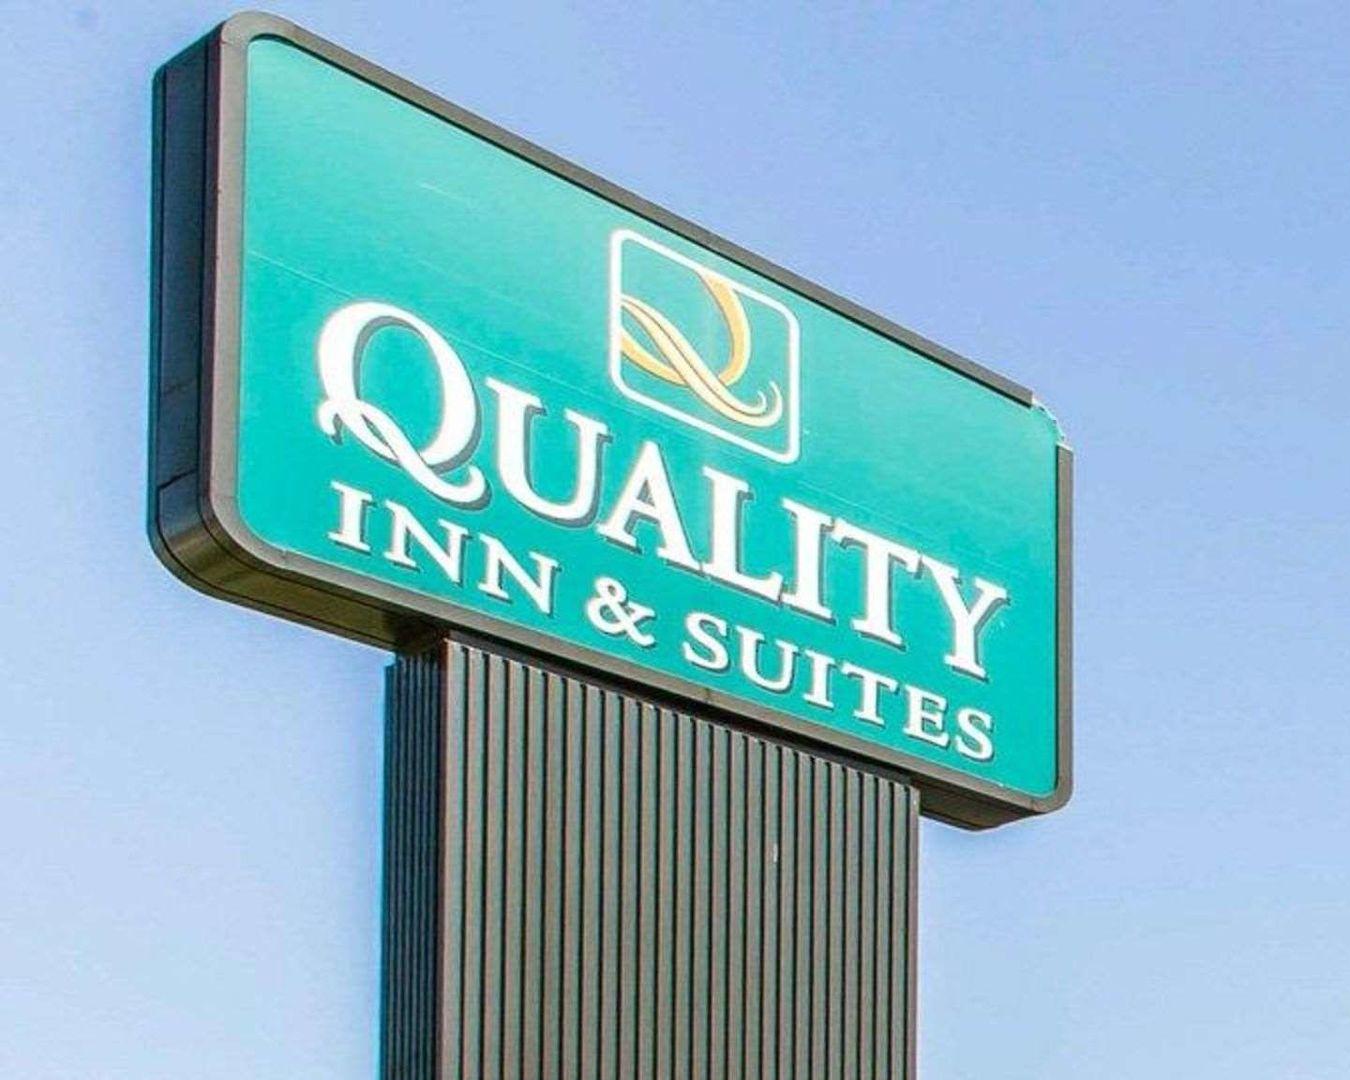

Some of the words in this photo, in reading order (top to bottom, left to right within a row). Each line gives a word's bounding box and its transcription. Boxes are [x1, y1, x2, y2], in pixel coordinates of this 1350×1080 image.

[315, 301, 1010, 680] QUALITY
[328, 480, 561, 616] INN
[585, 576, 657, 648] &
[682, 612, 996, 763] SUITES
